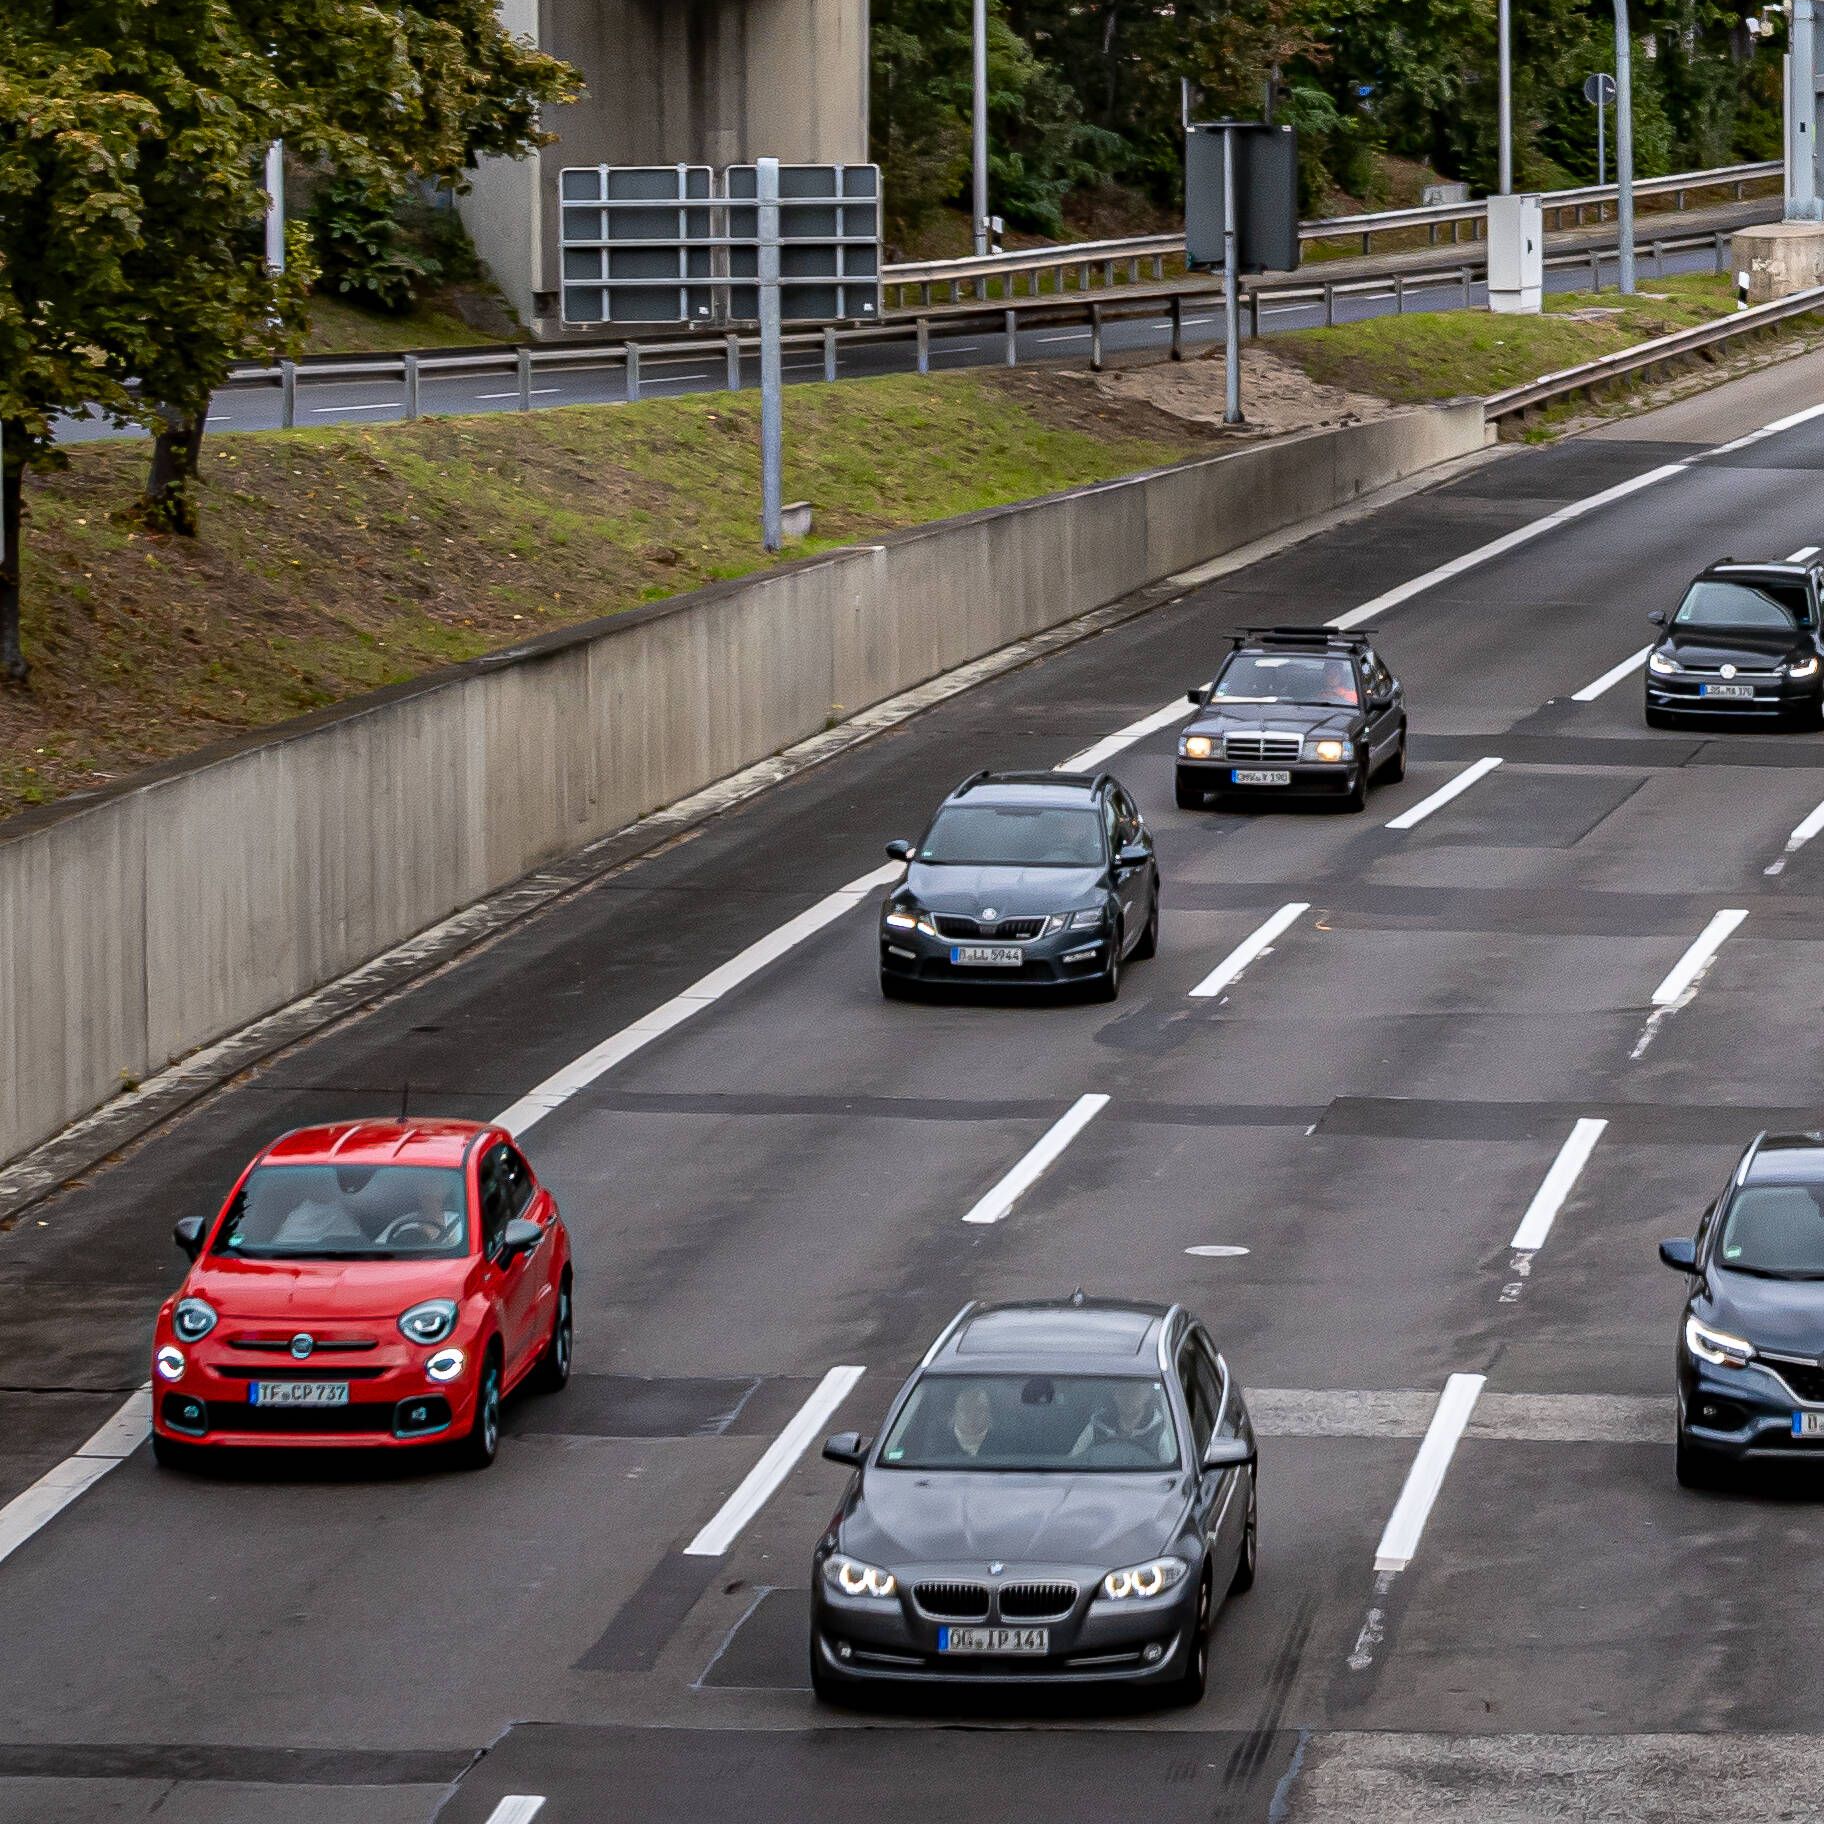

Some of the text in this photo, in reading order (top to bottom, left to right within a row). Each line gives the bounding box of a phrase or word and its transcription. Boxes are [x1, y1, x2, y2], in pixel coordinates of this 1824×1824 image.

[261, 1384, 346, 1400] TF CP 737
